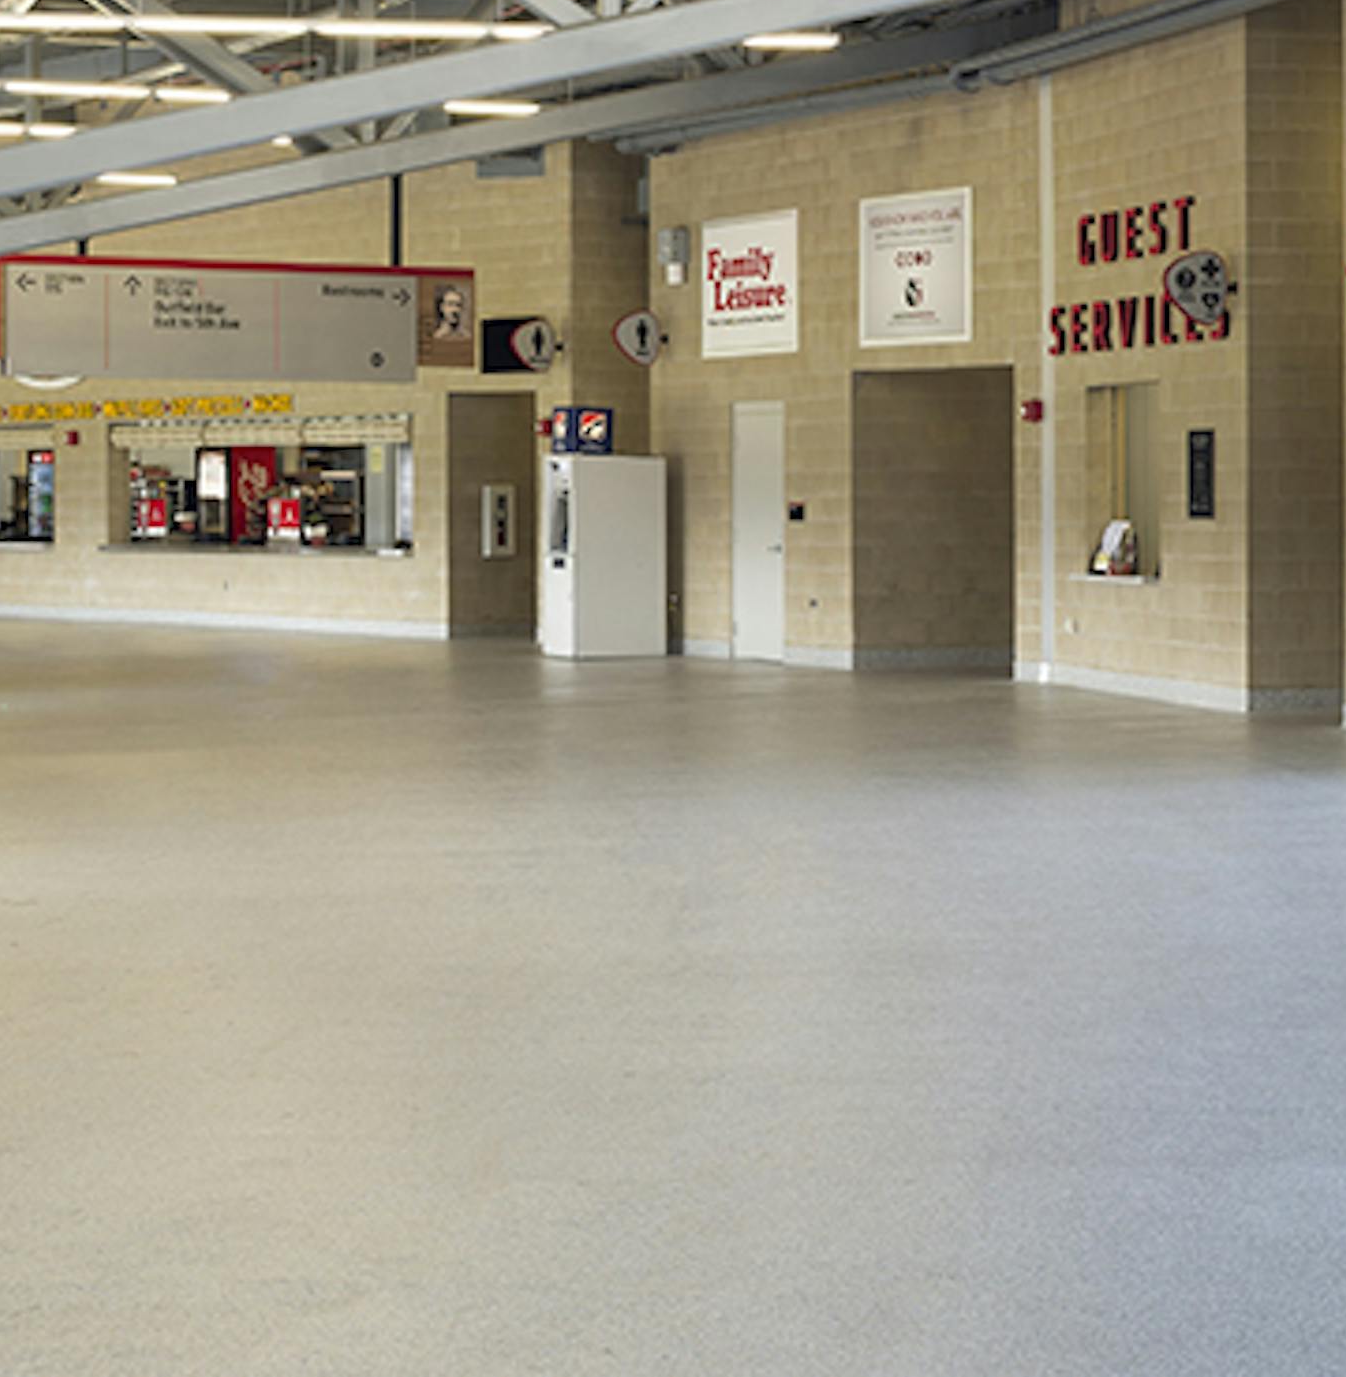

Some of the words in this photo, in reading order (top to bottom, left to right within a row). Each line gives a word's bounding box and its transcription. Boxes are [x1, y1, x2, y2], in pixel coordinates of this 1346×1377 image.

[1077, 196, 1195, 266] GUEST
[707, 247, 774, 281] Family
[715, 281, 786, 311] Leisure
